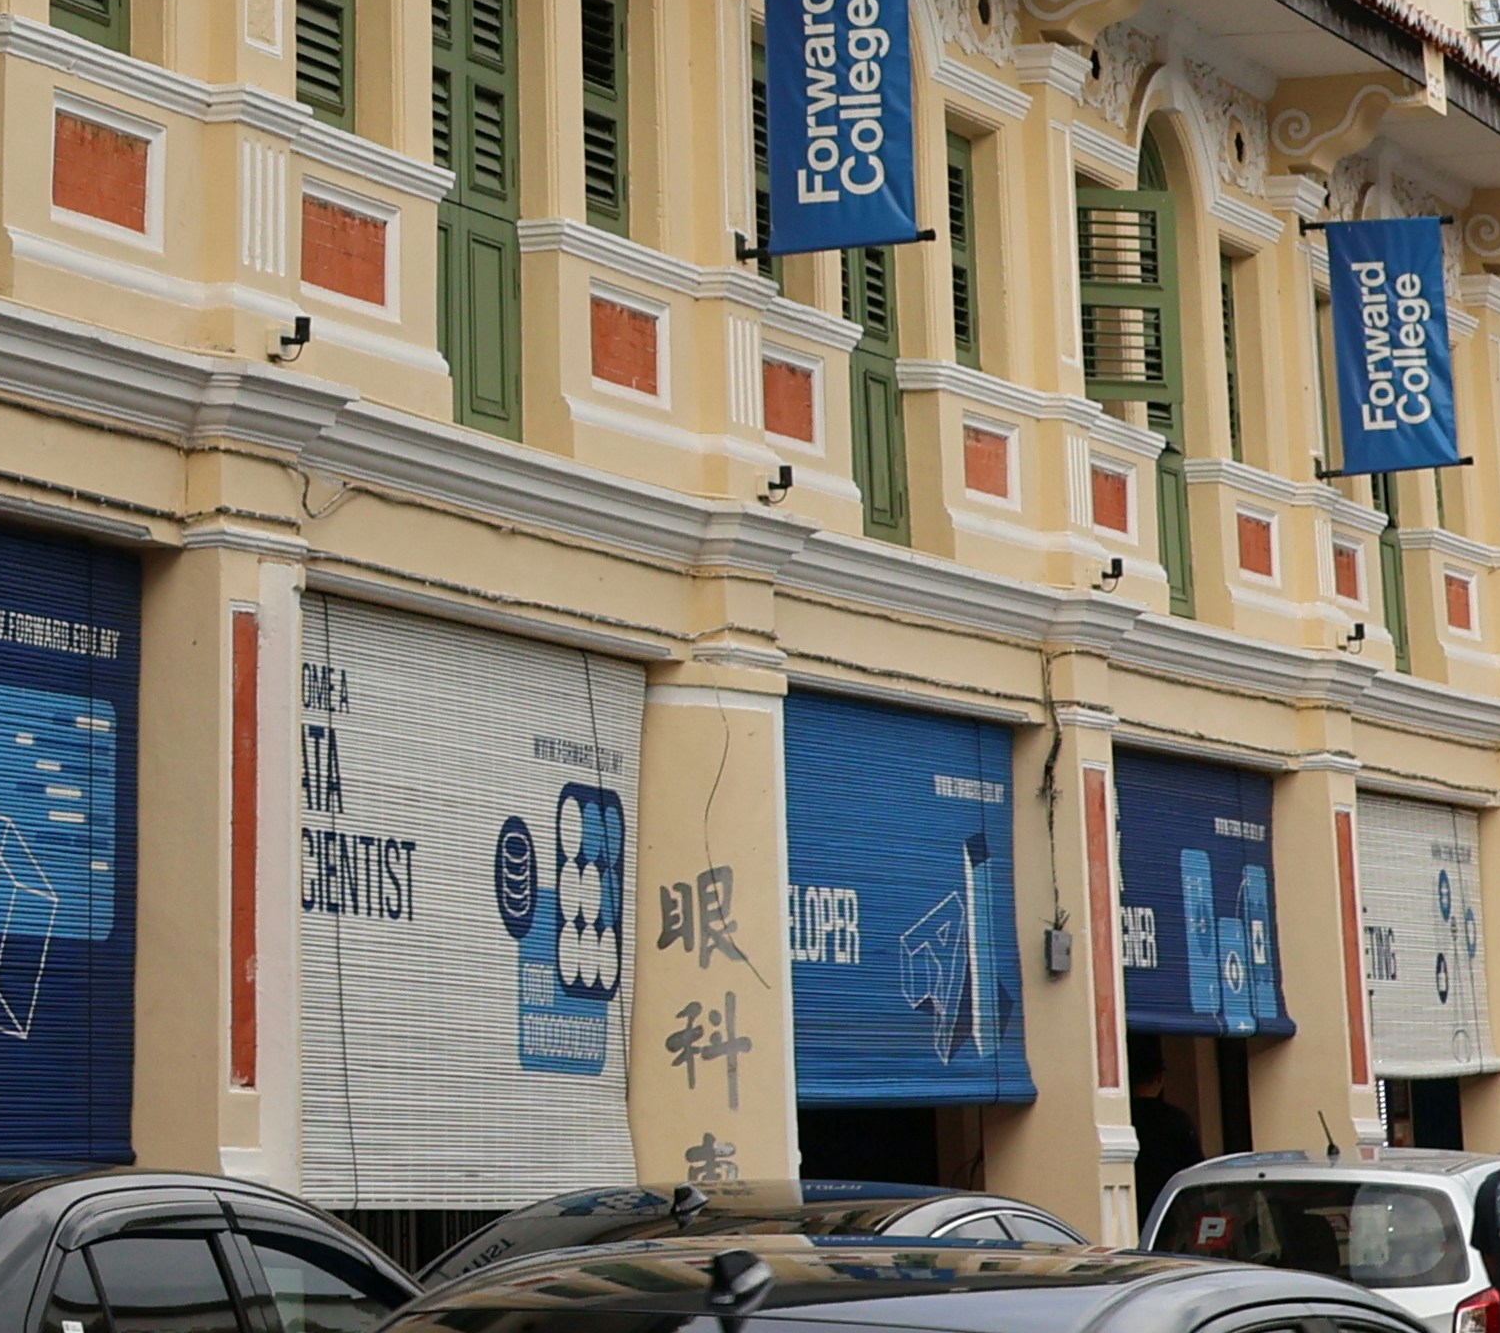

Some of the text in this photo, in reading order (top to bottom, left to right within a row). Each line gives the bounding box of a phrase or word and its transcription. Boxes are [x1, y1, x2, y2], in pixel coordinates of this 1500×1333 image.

[1351, 261, 1397, 431] Forward
[1393, 272, 1431, 424] College
[1197, 1217, 1227, 1244] P
